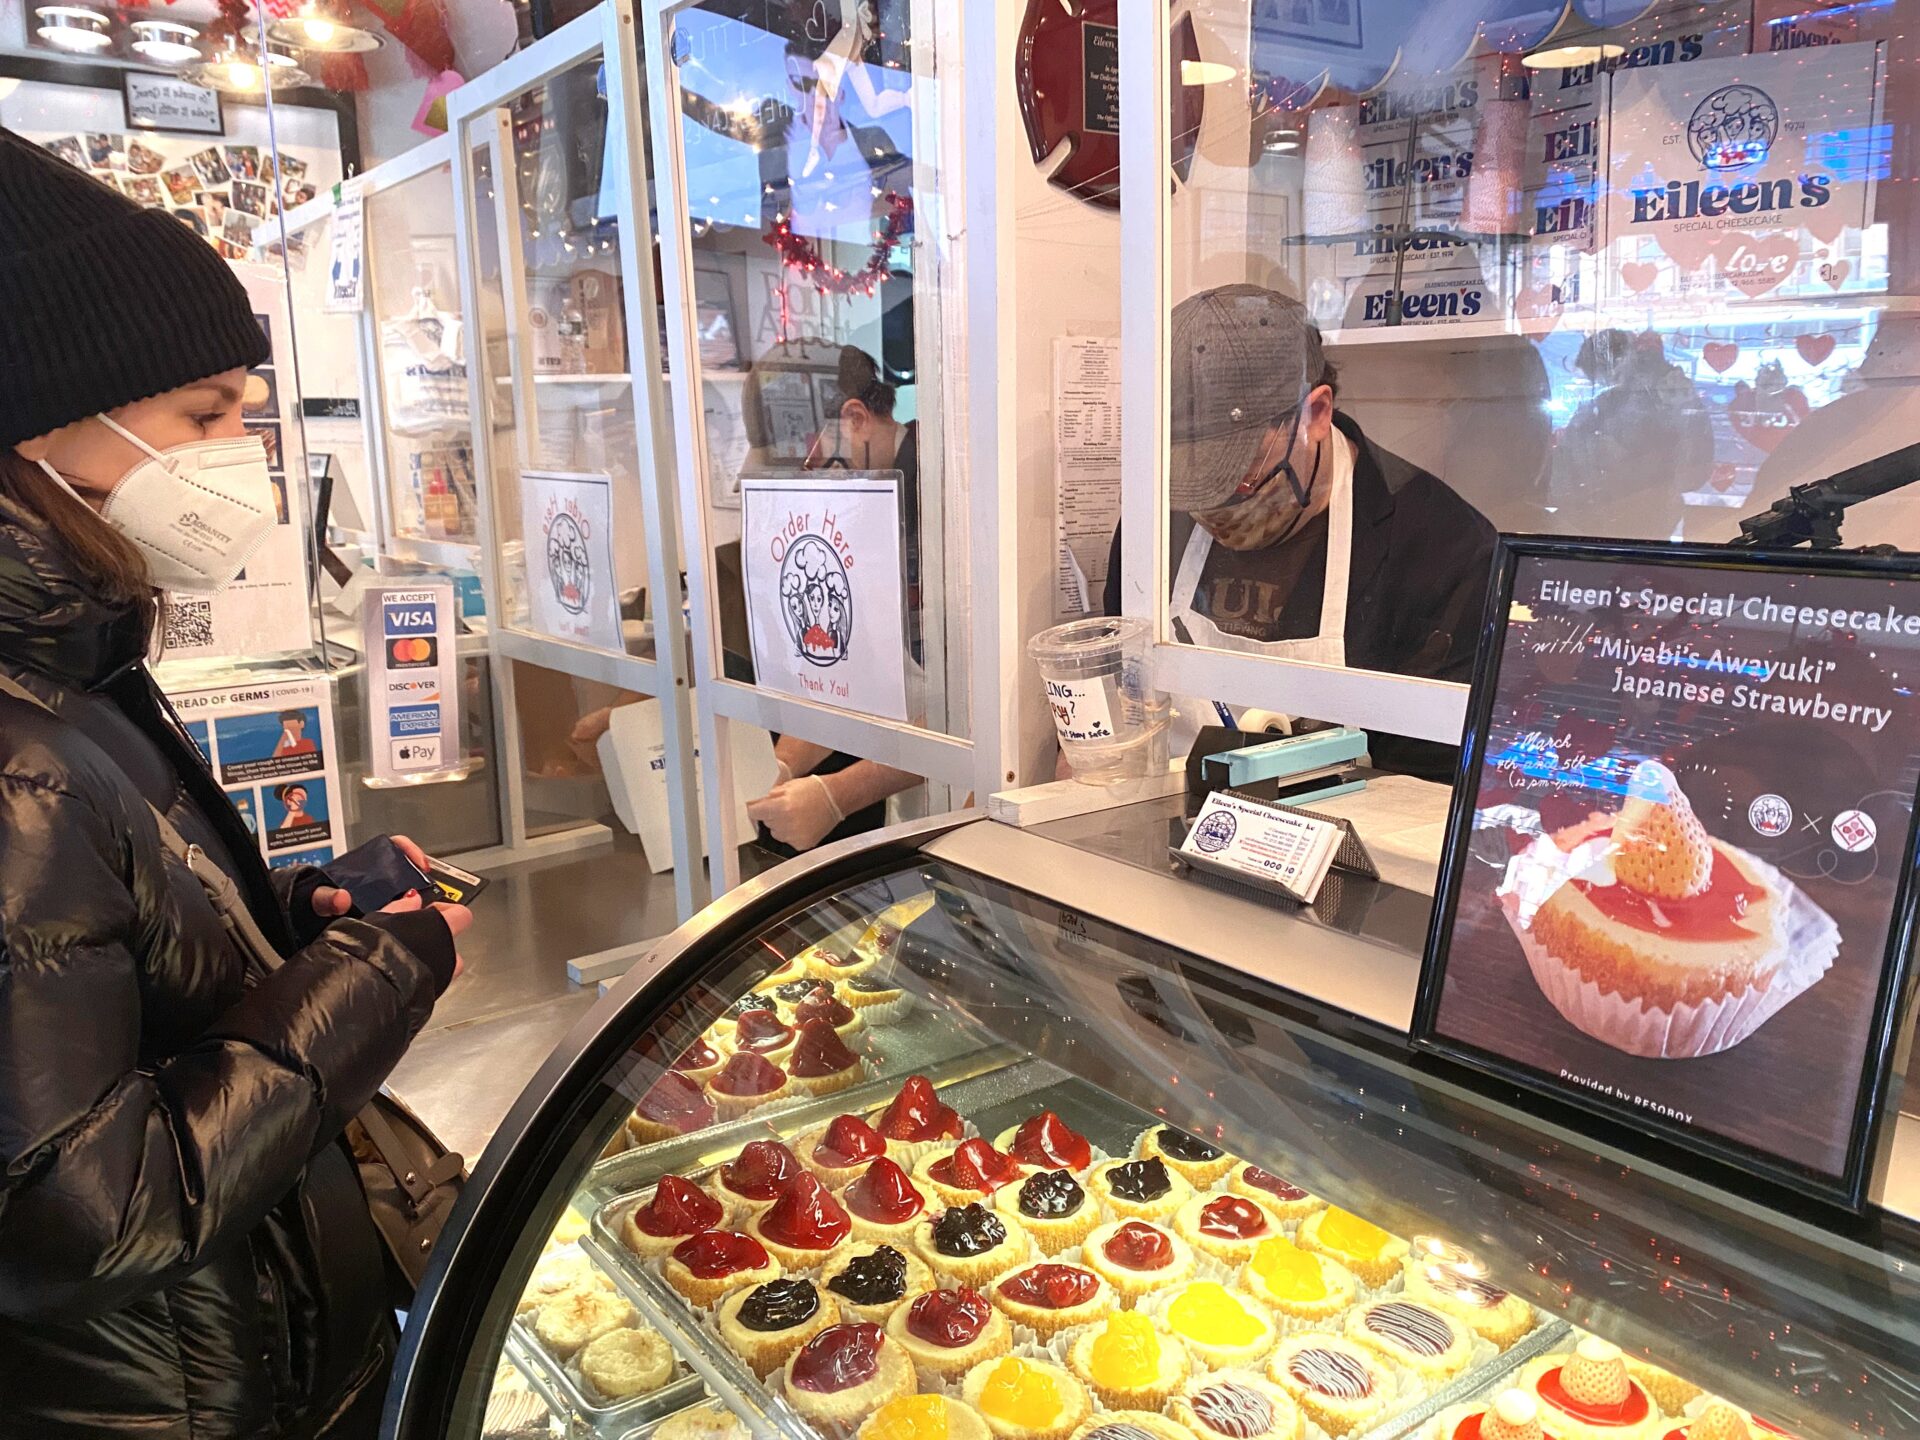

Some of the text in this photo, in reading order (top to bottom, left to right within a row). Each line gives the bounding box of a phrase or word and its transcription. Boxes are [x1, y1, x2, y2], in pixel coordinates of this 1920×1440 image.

[1630, 173, 1831, 224] Eileen's
[1673, 214, 1783, 233] SPECIAL CHEESECAKE
[770, 508, 854, 569] Order Here
[383, 593, 435, 602] WE ACCEPT
[1540, 579, 1920, 636] Eileen's Special Cheesecake
[388, 610, 435, 627] VISA
[1531, 623, 1594, 655] with
[389, 680, 436, 692] DISCOVER
[798, 672, 849, 697] Thank You!
[170, 697, 208, 710] PREAD
[211, 695, 227, 705] OF
[230, 690, 270, 703] GERMS
[1612, 667, 1892, 733] Japanese Strawberry
[390, 710, 437, 721] AMERICAN
[401, 720, 440, 730] EXPRESS
[1519, 732, 1572, 752] March
[412, 745, 436, 761] Pay
[1562, 754, 1586, 770] 5th
[1211, 797, 1236, 810] Eileen's
[1238, 805, 1262, 817] Special
[1560, 1068, 1613, 1096] Provided
